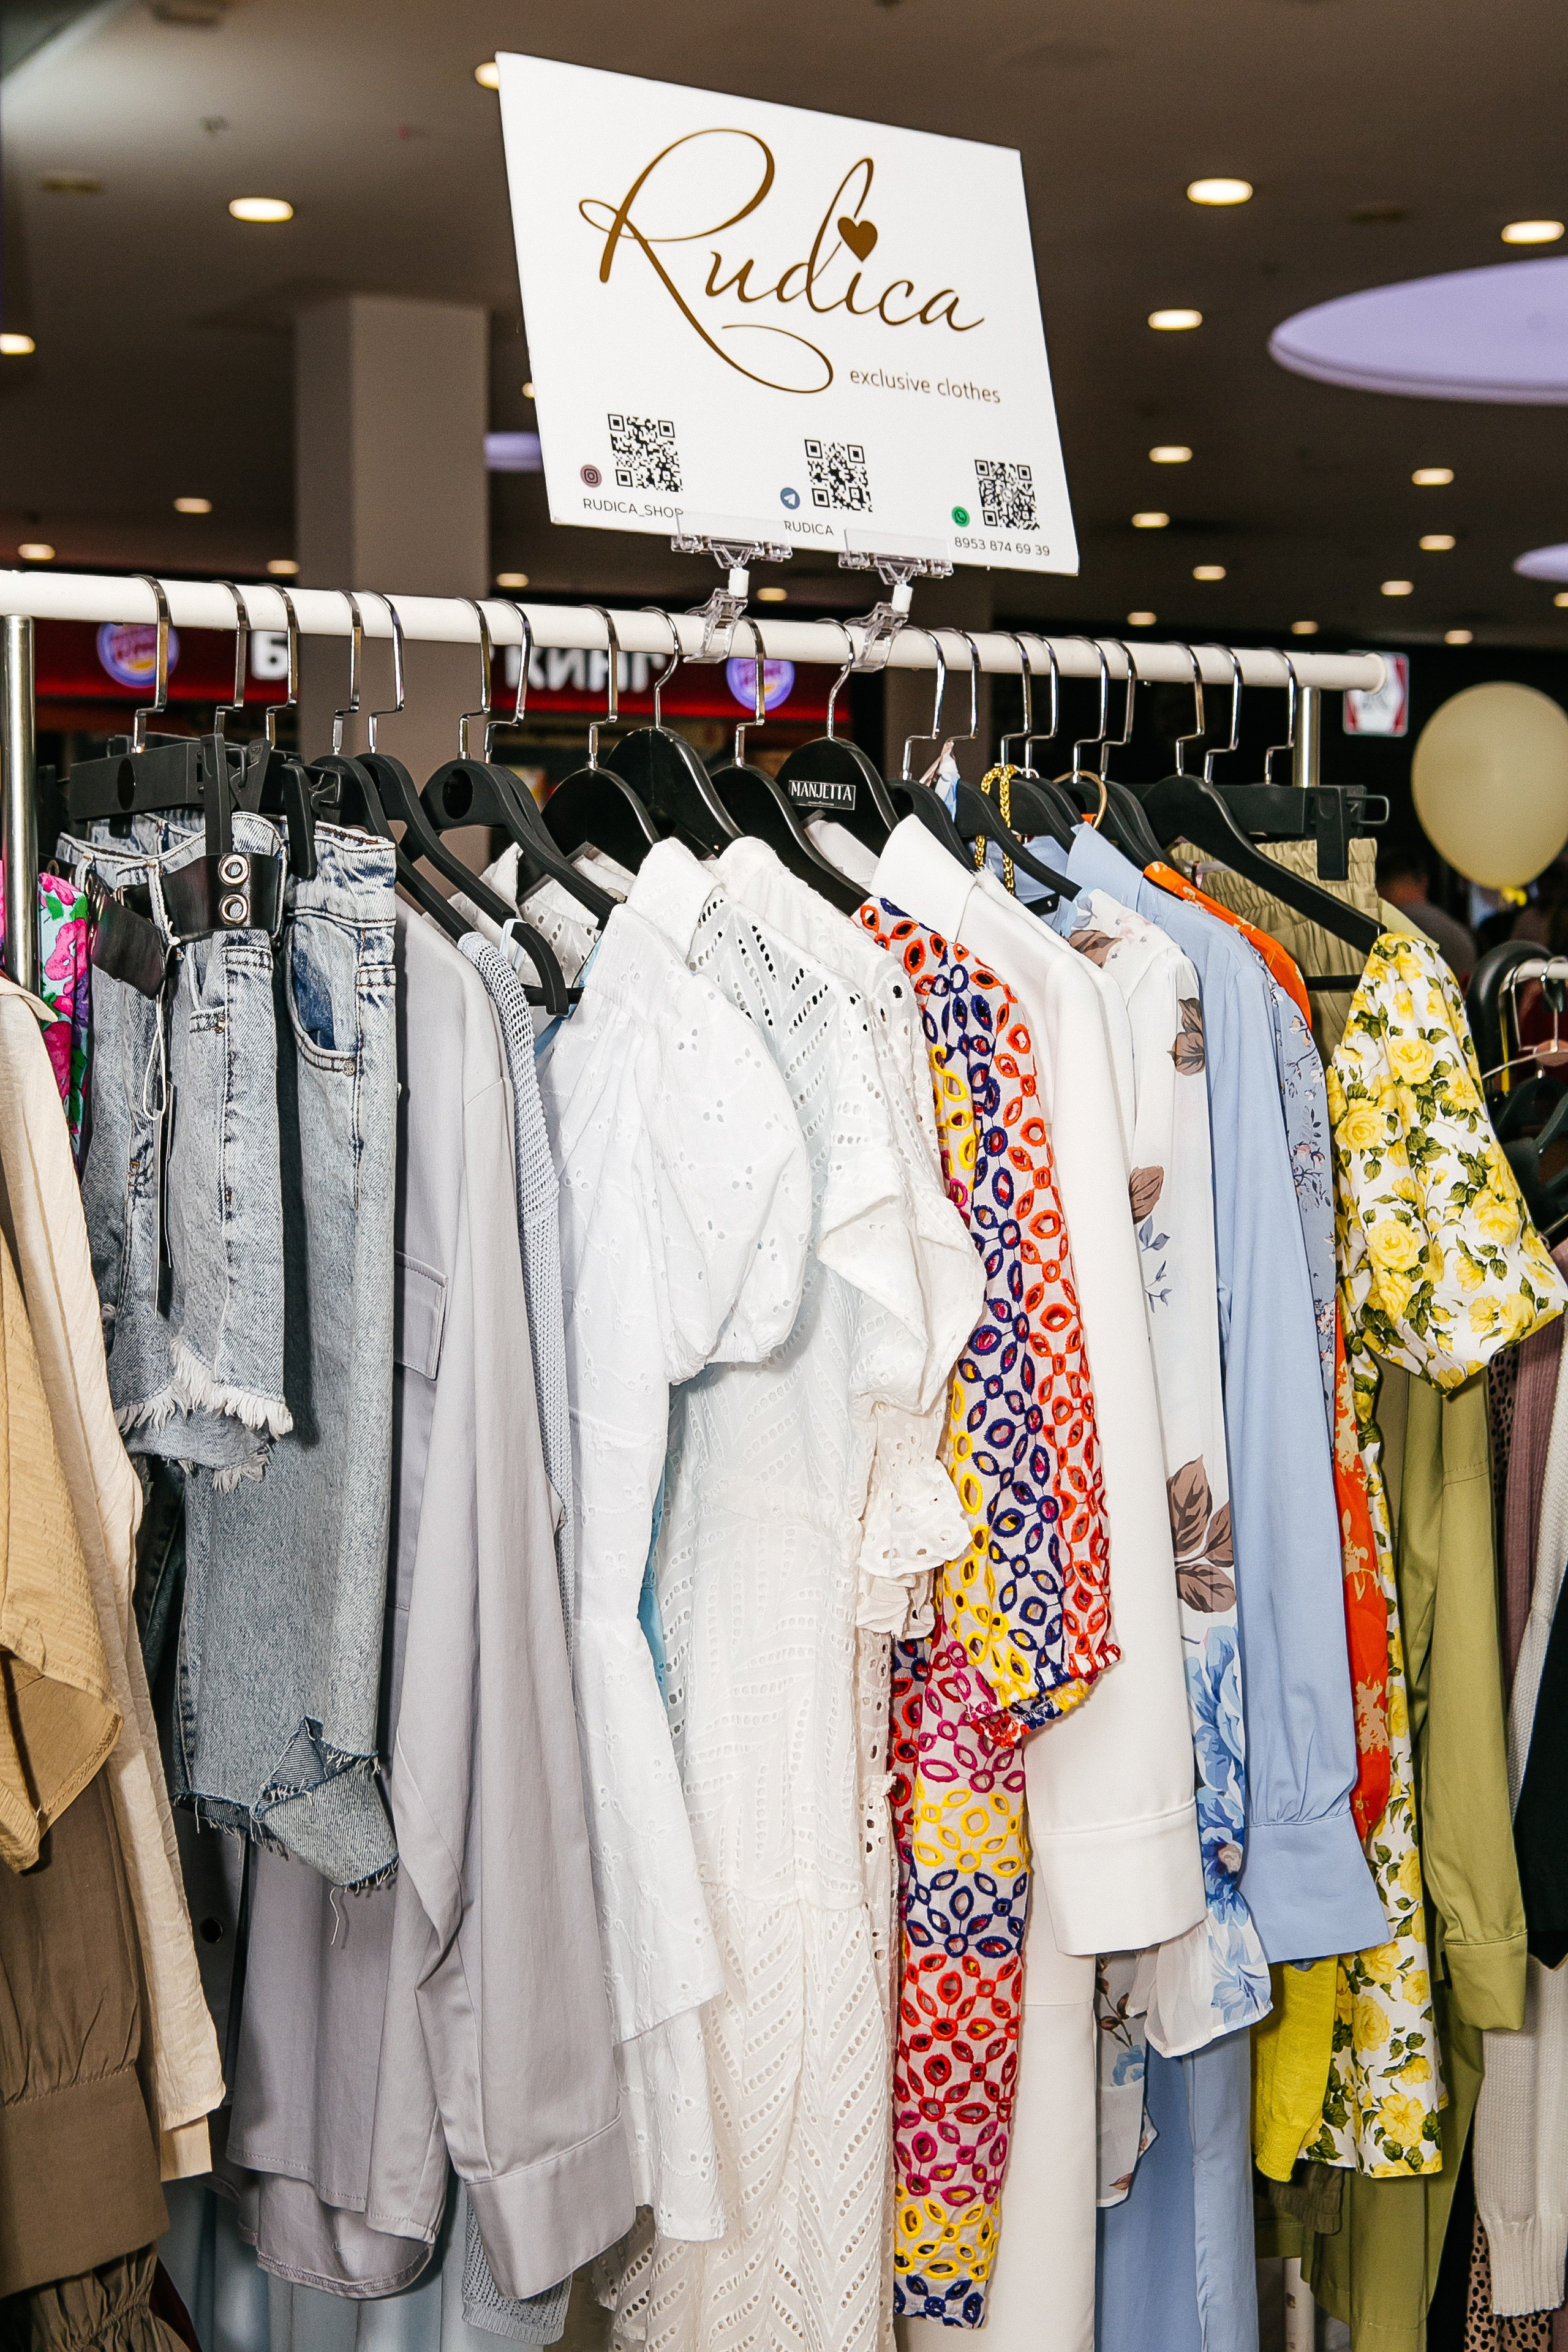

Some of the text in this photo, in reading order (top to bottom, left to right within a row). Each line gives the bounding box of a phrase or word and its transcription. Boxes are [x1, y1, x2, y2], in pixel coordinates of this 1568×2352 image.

[579, 128, 984, 393] Rudica
[850, 369, 1001, 403] exclusive clothes
[583, 498, 684, 518] RUDICA_SHOP
[784, 520, 834, 536] RUDICA
[954, 537, 1050, 556] 8953 874 69 39
[791, 781, 852, 801] MANJETTA
